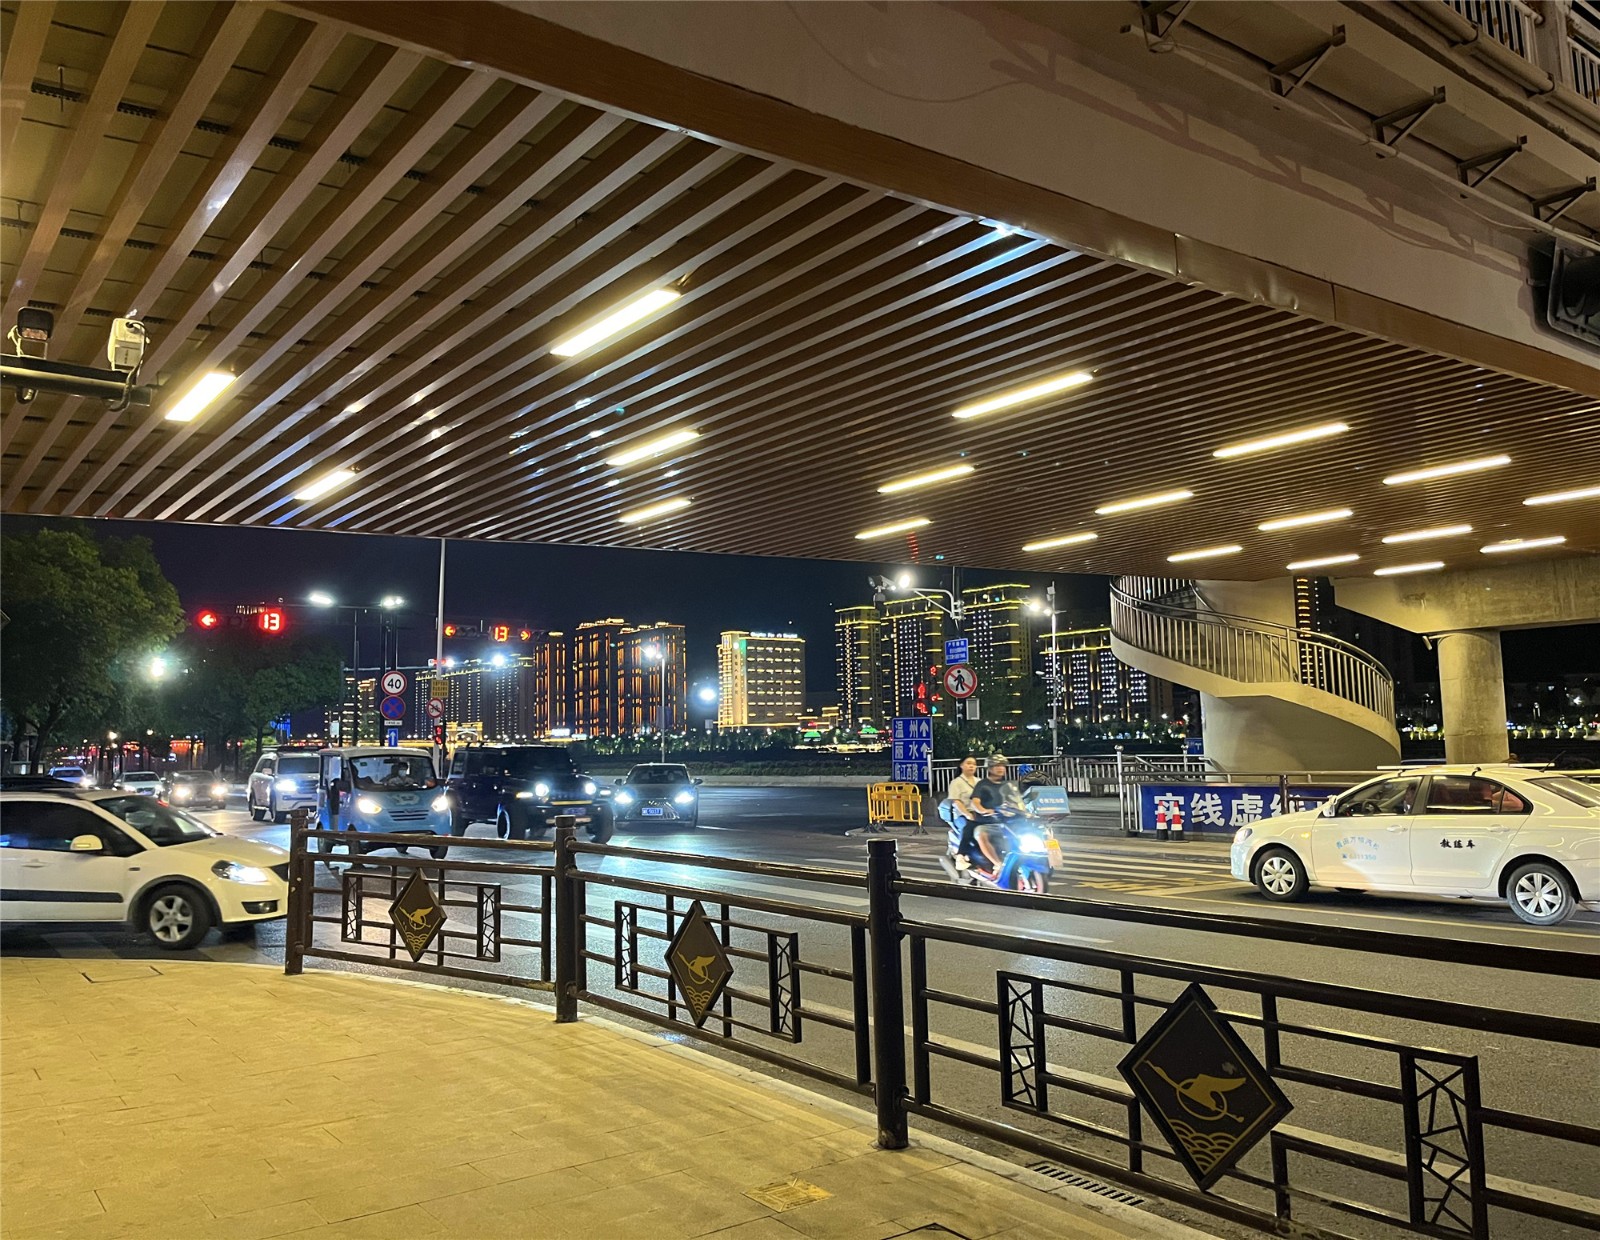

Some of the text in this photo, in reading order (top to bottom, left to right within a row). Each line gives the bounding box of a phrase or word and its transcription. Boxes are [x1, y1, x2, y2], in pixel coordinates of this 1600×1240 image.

[263, 613, 280, 631] 13
[494, 626, 508, 641] 13
[387, 678, 402, 690] 40
[895, 720, 919, 738] 温州
[894, 741, 919, 760] 丽水
[894, 763, 918, 781] 临江西路
[1440, 838, 1476, 849] 教练车
